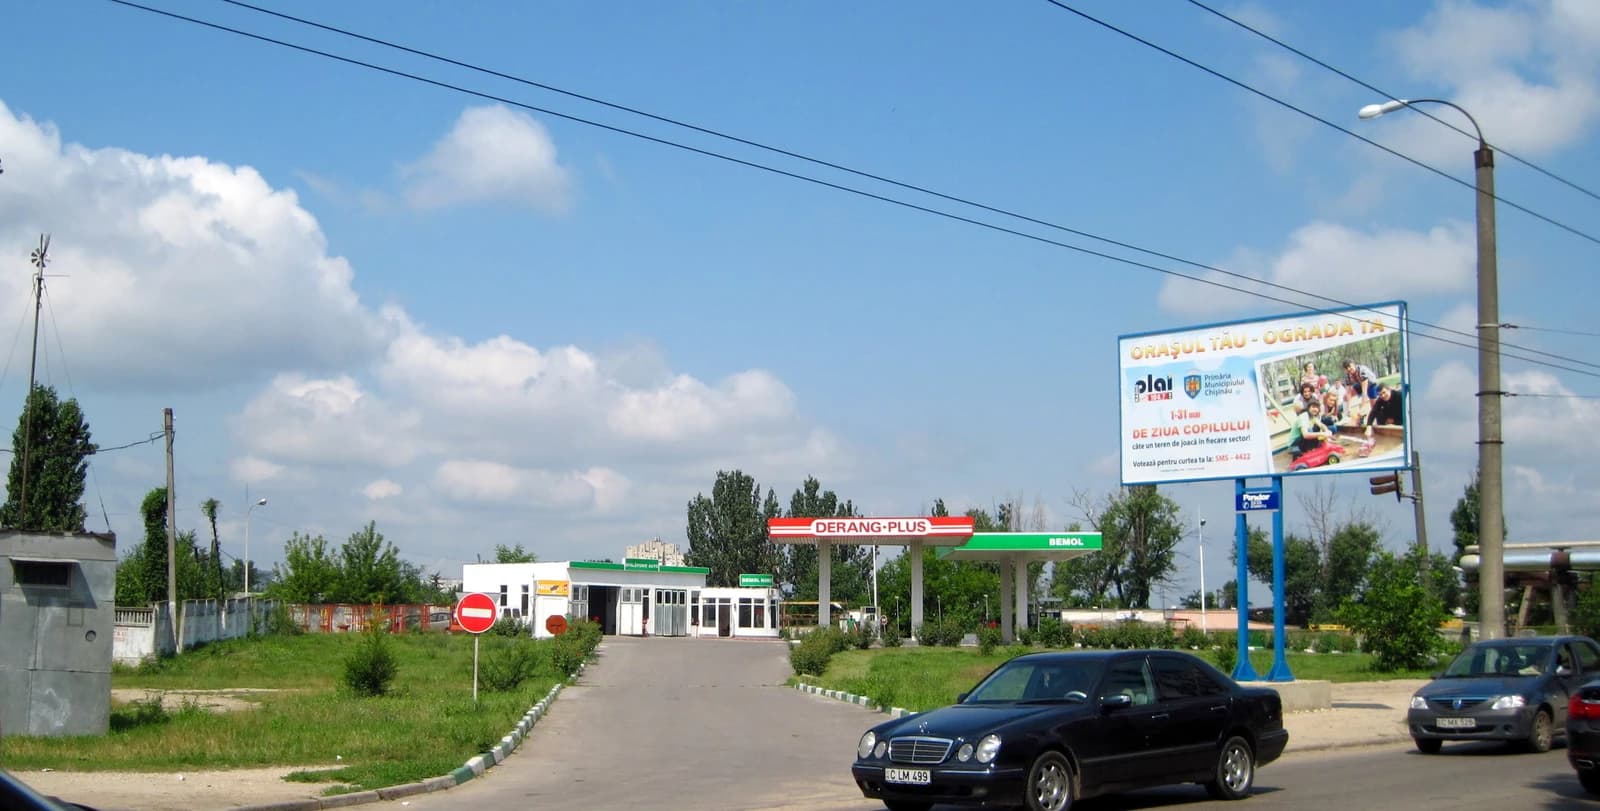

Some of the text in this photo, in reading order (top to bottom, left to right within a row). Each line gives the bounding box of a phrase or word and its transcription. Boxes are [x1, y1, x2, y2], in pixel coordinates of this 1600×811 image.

[1209, 331, 1247, 351] TĂU
[1263, 321, 1354, 344] OGRADA
[1358, 318, 1385, 334] TA
[1135, 374, 1173, 394] plai
[1204, 373, 1231, 381] Primăria
[1204, 378, 1245, 388] Municipiului
[1133, 420, 1251, 439] DE ZIUA COPILULUI
[1154, 440, 1171, 448] teren
[1171, 439, 1180, 447] de
[1180, 438, 1197, 448] joacă
[1229, 434, 1251, 443] sector!
[1133, 460, 1156, 468] Votează
[1157, 457, 1178, 467] pentru
[1178, 456, 1198, 465] curtea
[1206, 455, 1214, 463] la:
[1215, 454, 1229, 462] SMS
[1048, 538, 1084, 546] BEMOL
[890, 769, 928, 782] C LM 499
